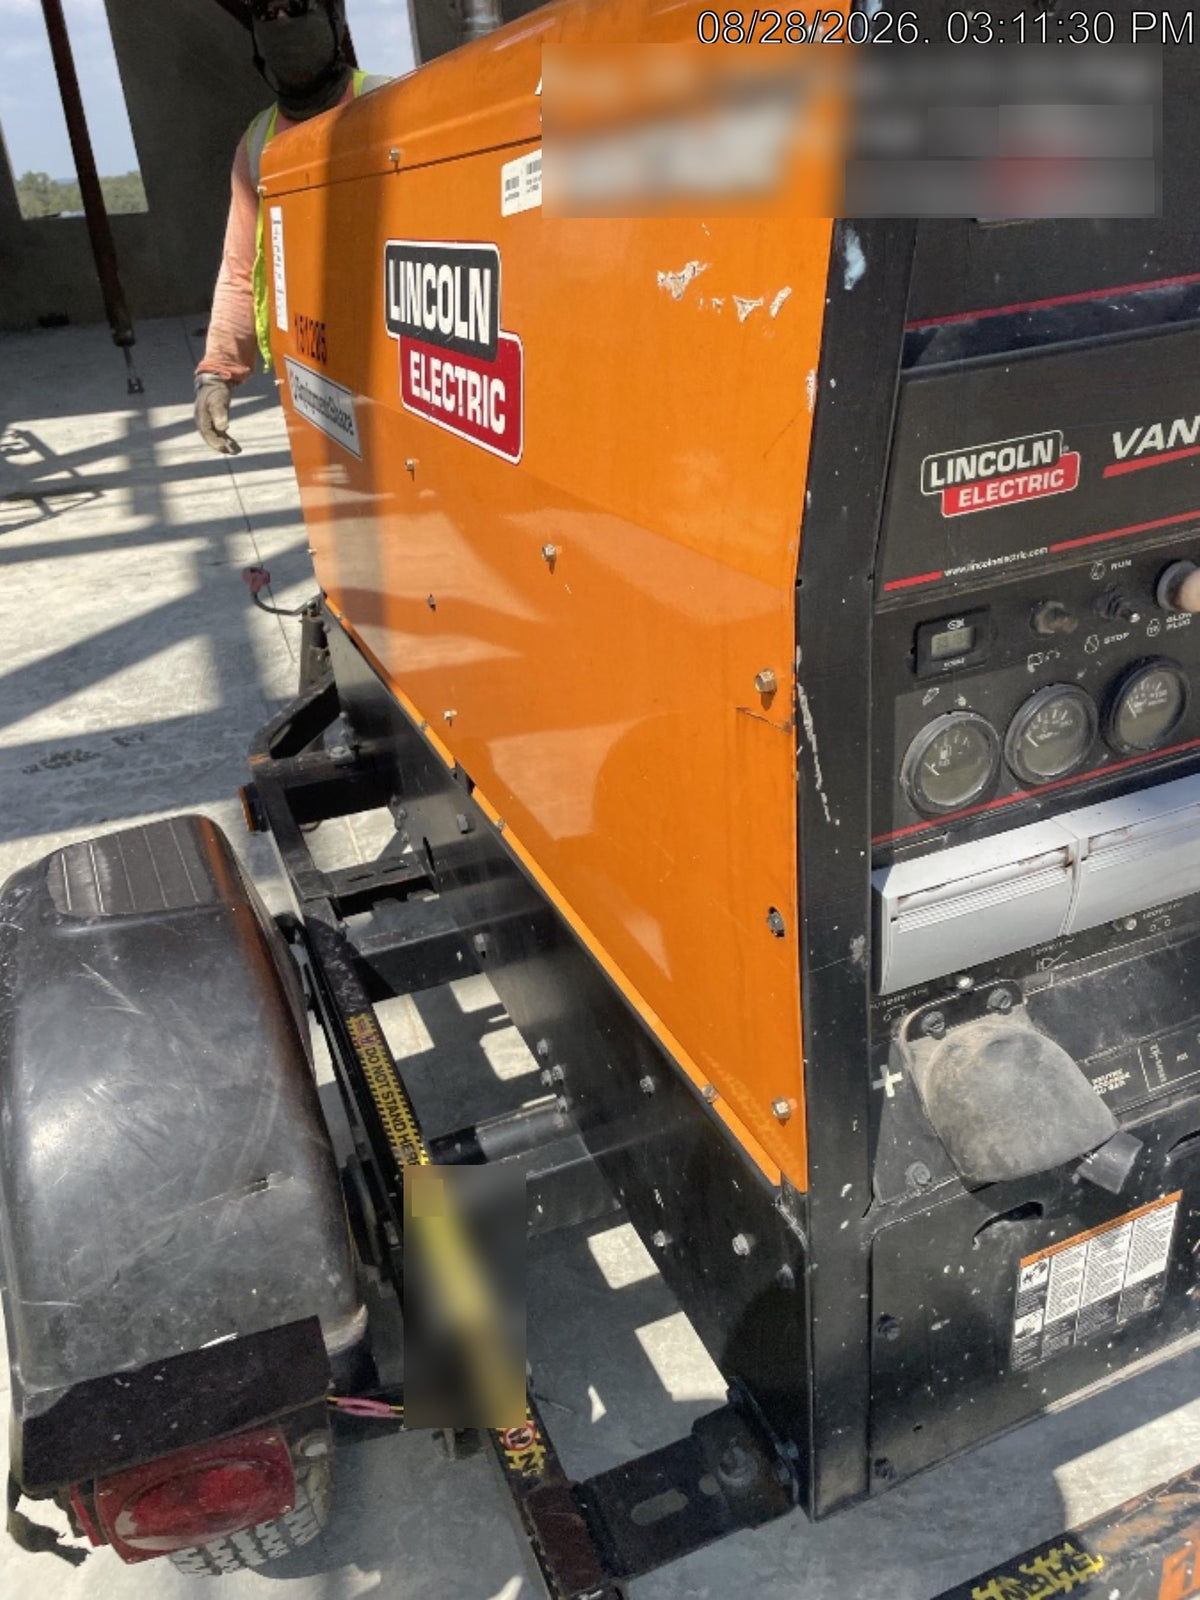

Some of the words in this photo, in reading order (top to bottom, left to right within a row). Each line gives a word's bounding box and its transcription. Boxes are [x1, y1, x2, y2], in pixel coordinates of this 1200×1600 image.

[388, 258, 491, 345] LINCOLN
[409, 350, 506, 435] ELECTRIC
[930, 438, 1054, 488] LINCOLN
[958, 468, 1064, 508] ELECTRIC
[1110, 559, 1132, 571] RUN
[1103, 632, 1130, 645] STOP
[365, 1047, 380, 1064] DO
[372, 1064, 391, 1089] NOT
[381, 1090, 407, 1133] STAND
